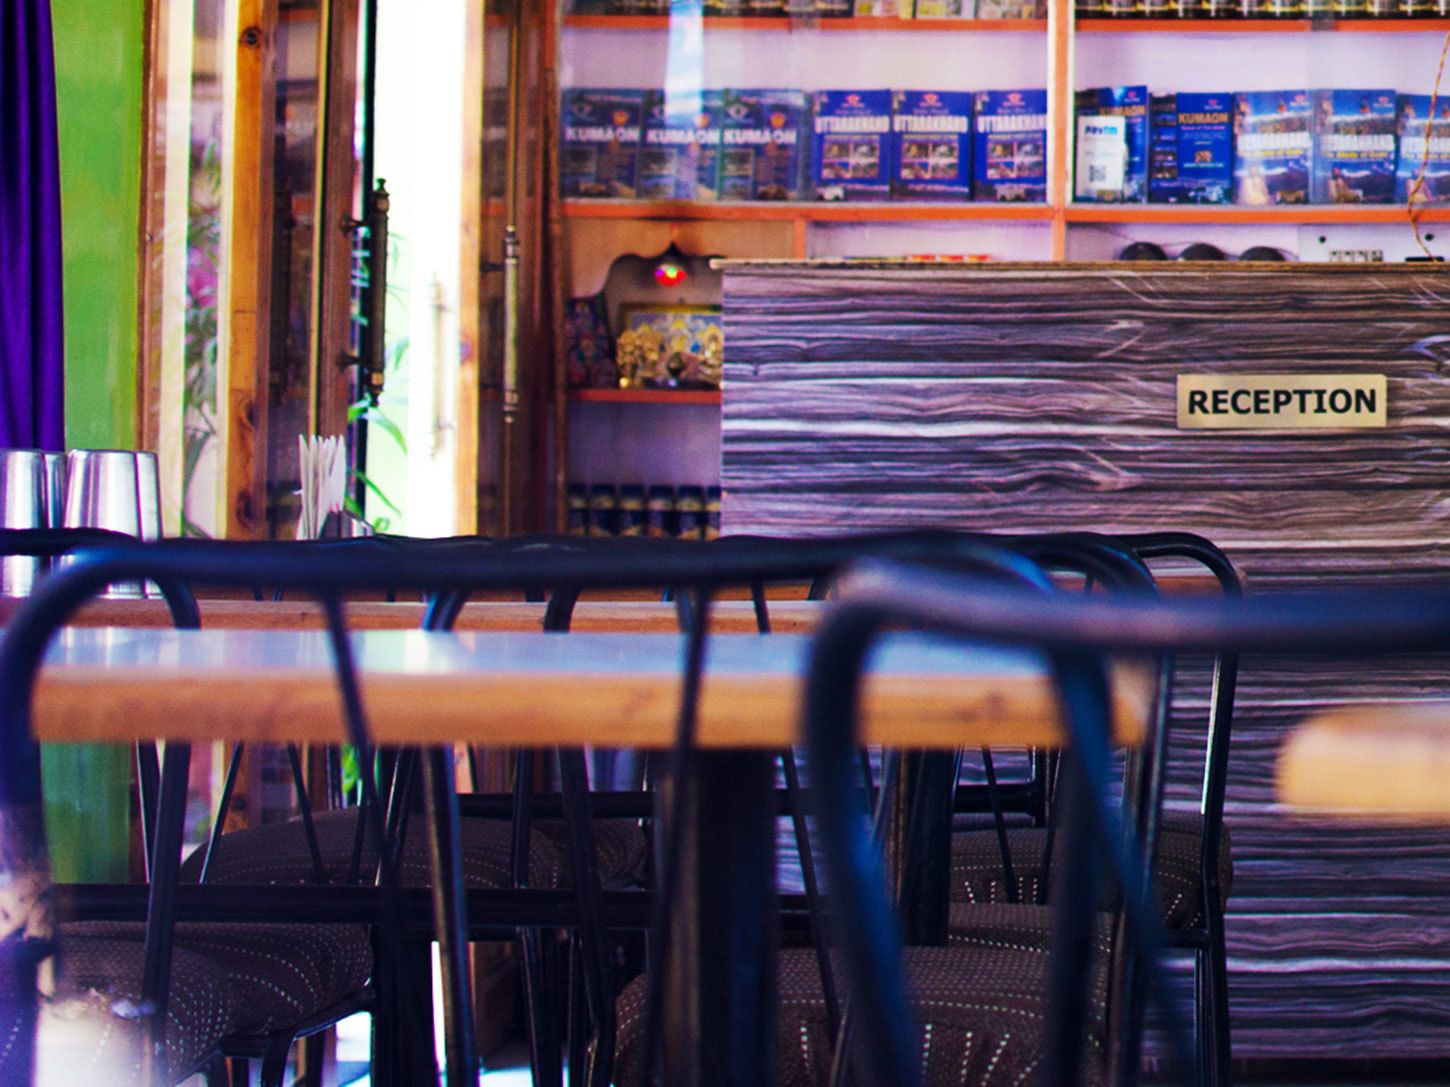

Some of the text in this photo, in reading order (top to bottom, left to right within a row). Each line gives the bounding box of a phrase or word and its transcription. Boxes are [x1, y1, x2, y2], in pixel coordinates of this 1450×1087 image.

[1178, 112, 1229, 124] KUMAON
[565, 126, 641, 142] KUMAON
[646, 128, 721, 144] KUMAON
[723, 128, 797, 144] KUMAON
[1188, 388, 1377, 415] RECEPTION
